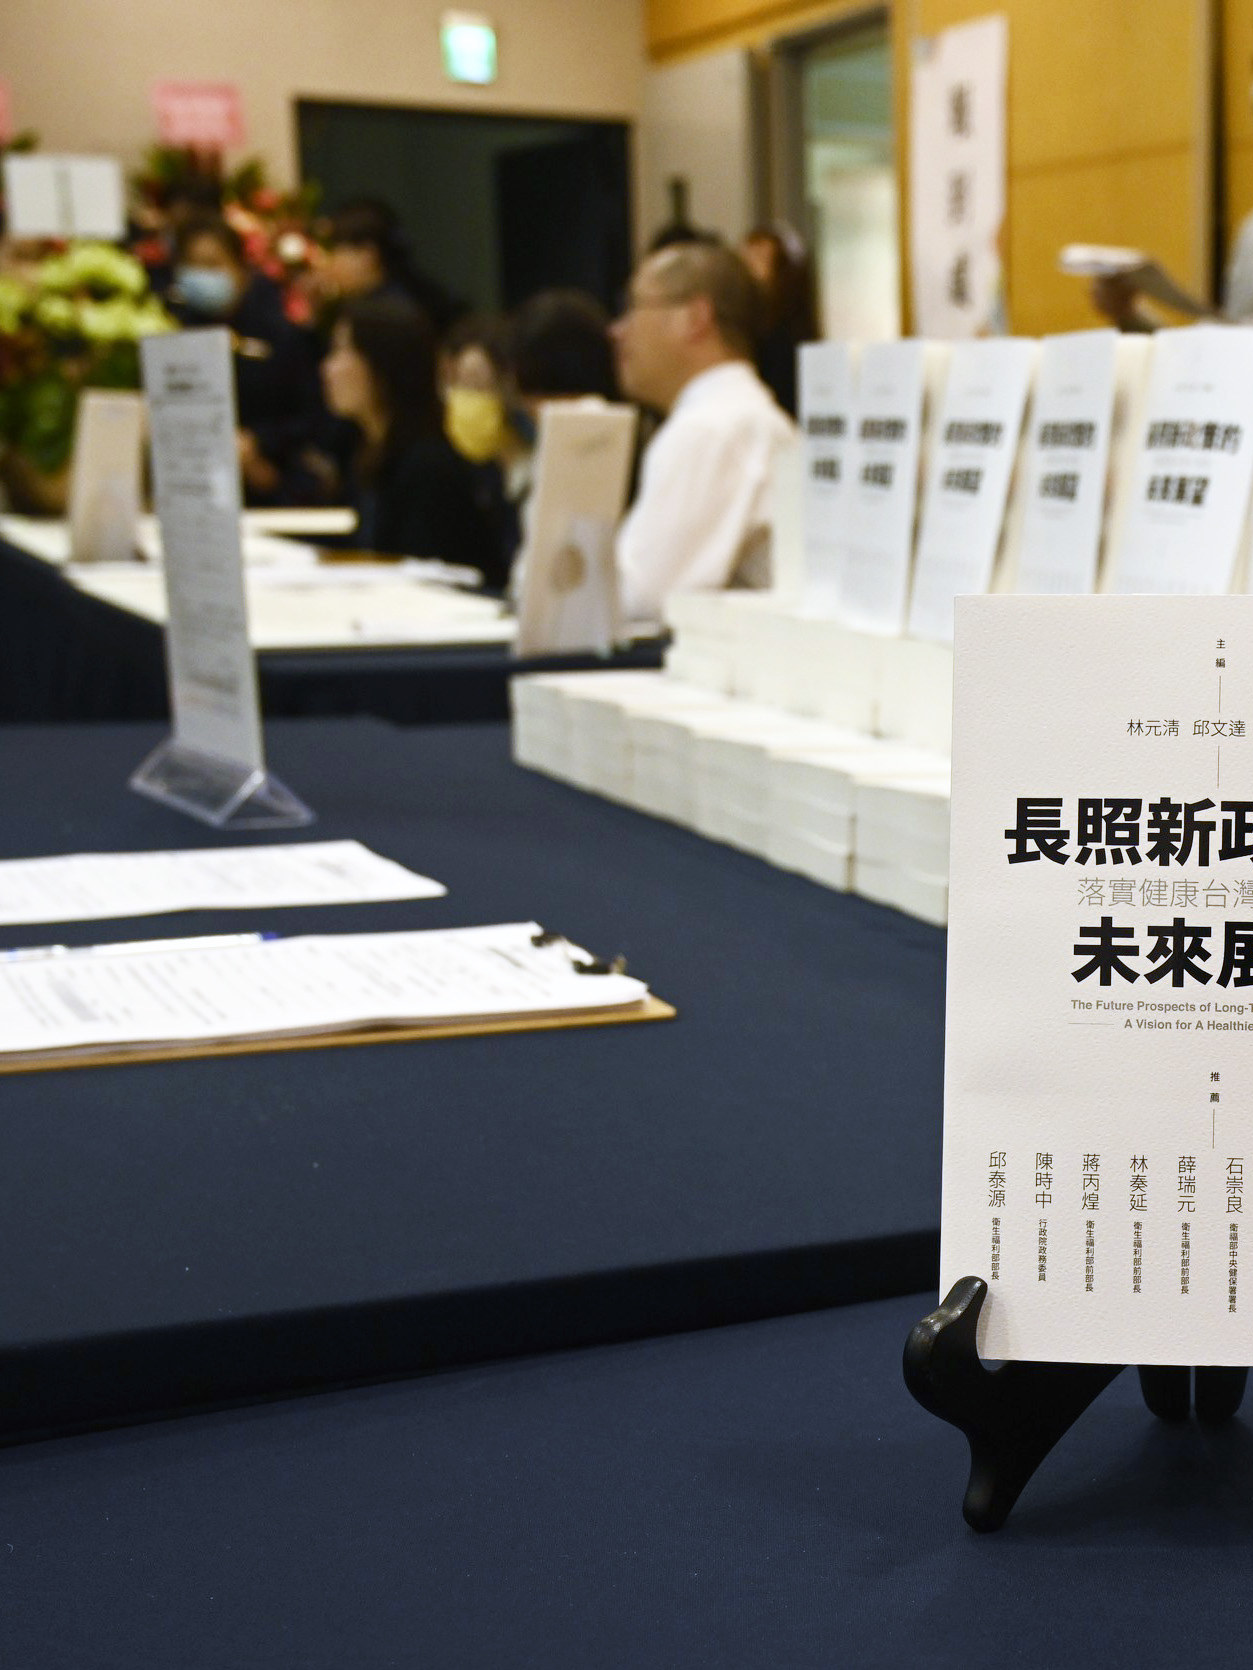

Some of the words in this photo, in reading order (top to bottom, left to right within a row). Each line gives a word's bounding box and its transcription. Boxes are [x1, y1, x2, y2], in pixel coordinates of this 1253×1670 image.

[1126, 719, 1180, 737] 林元清
[1192, 719, 1246, 738] 邱文達
[1071, 1000, 1093, 1011] The
[1096, 1000, 1134, 1012] Future
[1137, 1001, 1196, 1015] Prospects
[1199, 1002, 1212, 1013] of
[1124, 1019, 1133, 1029] A
[1136, 1019, 1172, 1030] Vision
[1175, 1020, 1192, 1031] for
[1195, 1020, 1204, 1031] A
[1209, 1072, 1221, 1103] 推薦
[988, 1151, 1007, 1208] 邱泰源
[1035, 1152, 1053, 1209] 陳時中
[1081, 1153, 1101, 1210] 蔣丙煌
[1129, 1154, 1148, 1212] 林奏延
[1177, 1155, 1197, 1213] 薛瑞元
[1225, 1157, 1244, 1214] 石崇良
[991, 1217, 1001, 1281] 衛生福利部部長
[1038, 1219, 1047, 1282] 行政院政務委員
[1085, 1220, 1095, 1292] 衛生福利部前部長
[1132, 1221, 1143, 1294] 衛生福利部前部長
[1180, 1222, 1191, 1295] 衛生福利部前部長
[1228, 1223, 1239, 1313] 衛福部中央健保署署長
